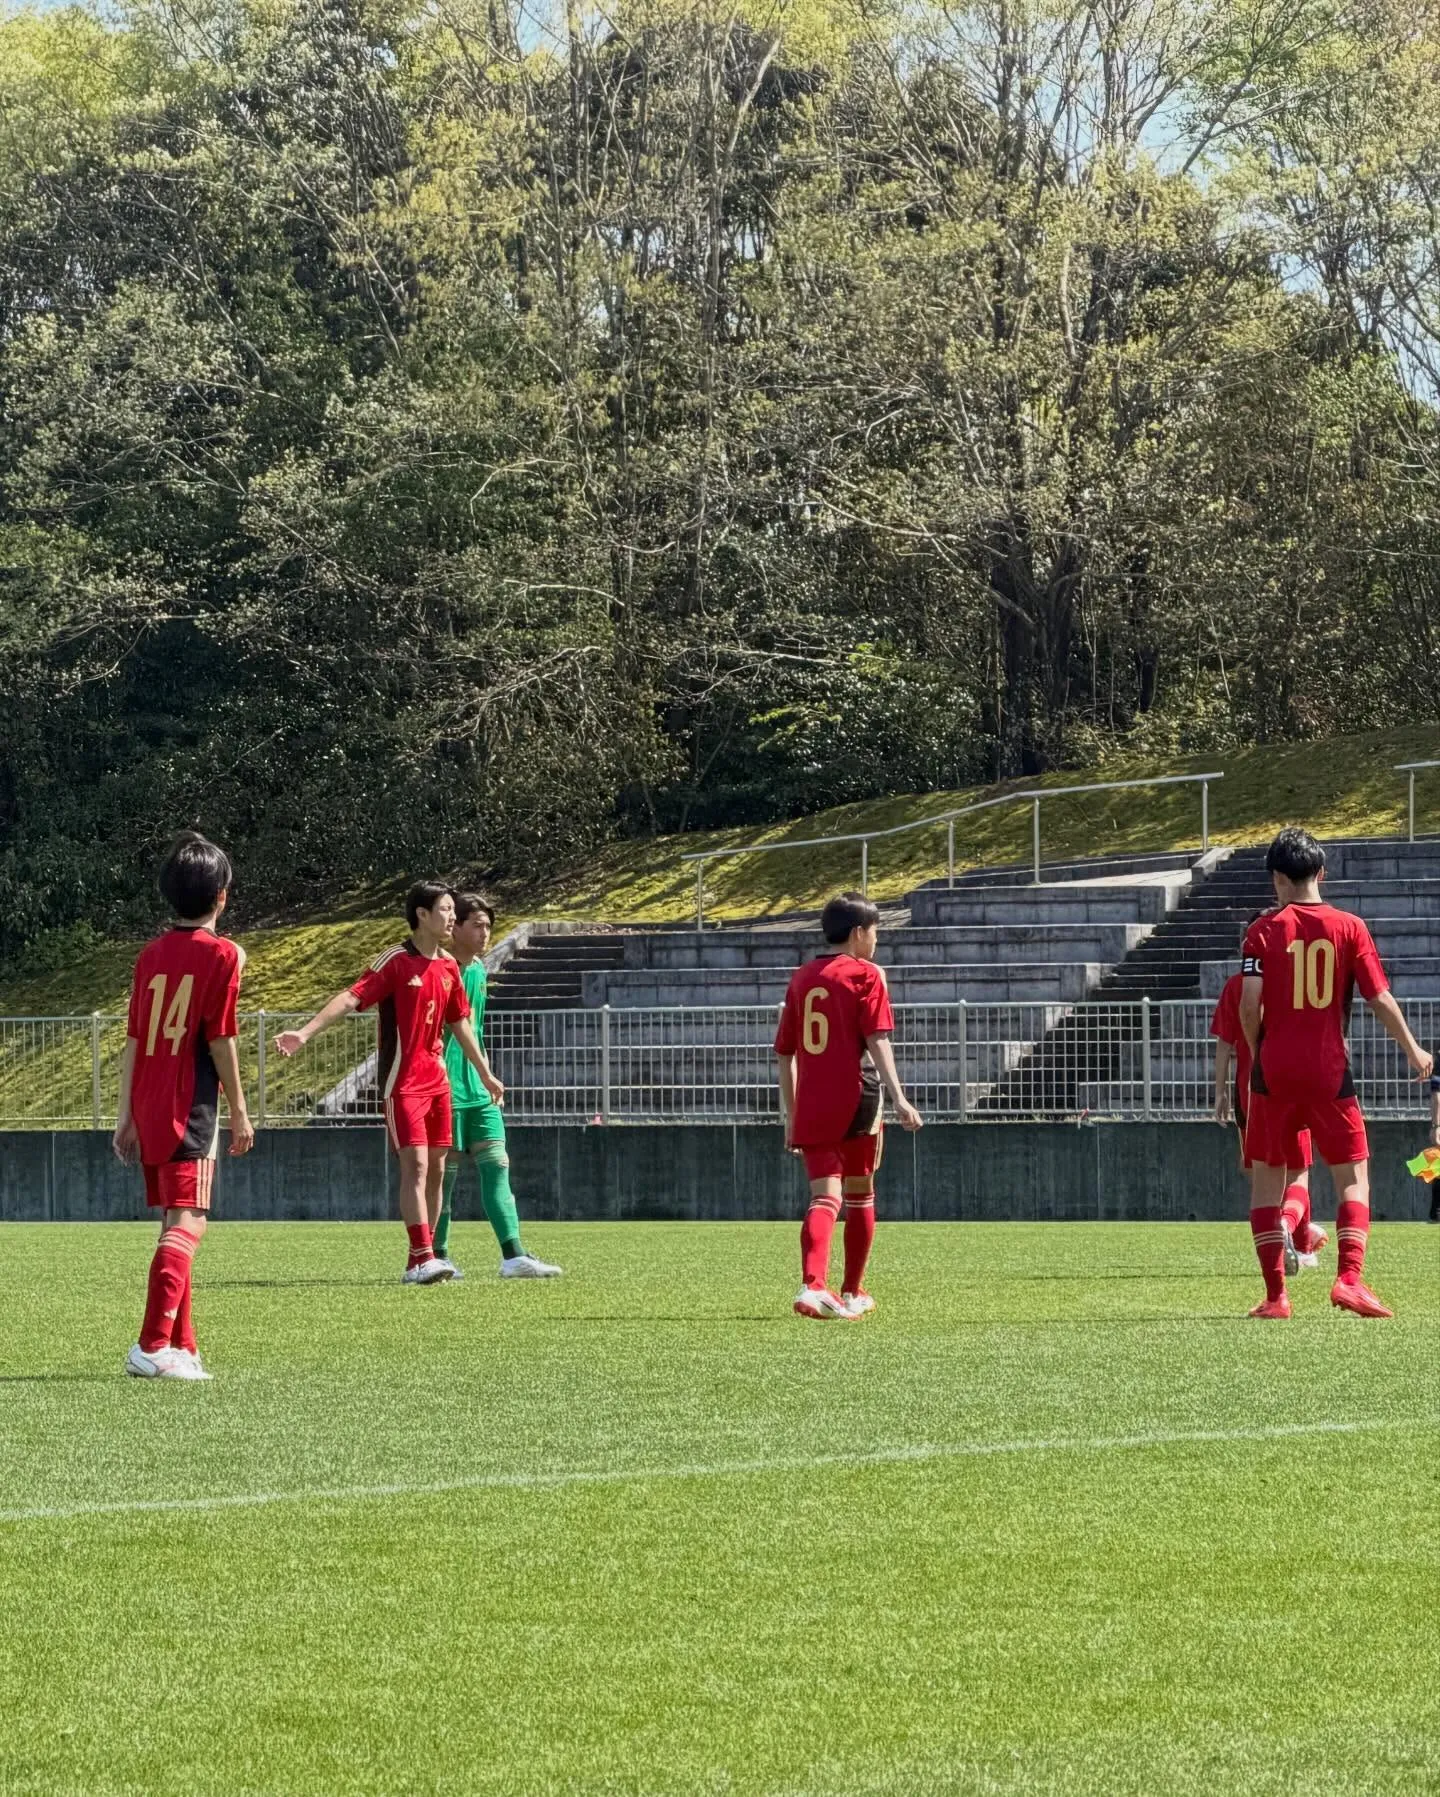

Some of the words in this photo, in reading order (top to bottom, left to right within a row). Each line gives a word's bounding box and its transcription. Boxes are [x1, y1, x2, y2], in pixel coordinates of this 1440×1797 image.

[1286, 938, 1335, 1010] 10
[145, 973, 195, 1056] 14
[425, 999, 436, 1025] 2
[803, 986, 830, 1055] 6
